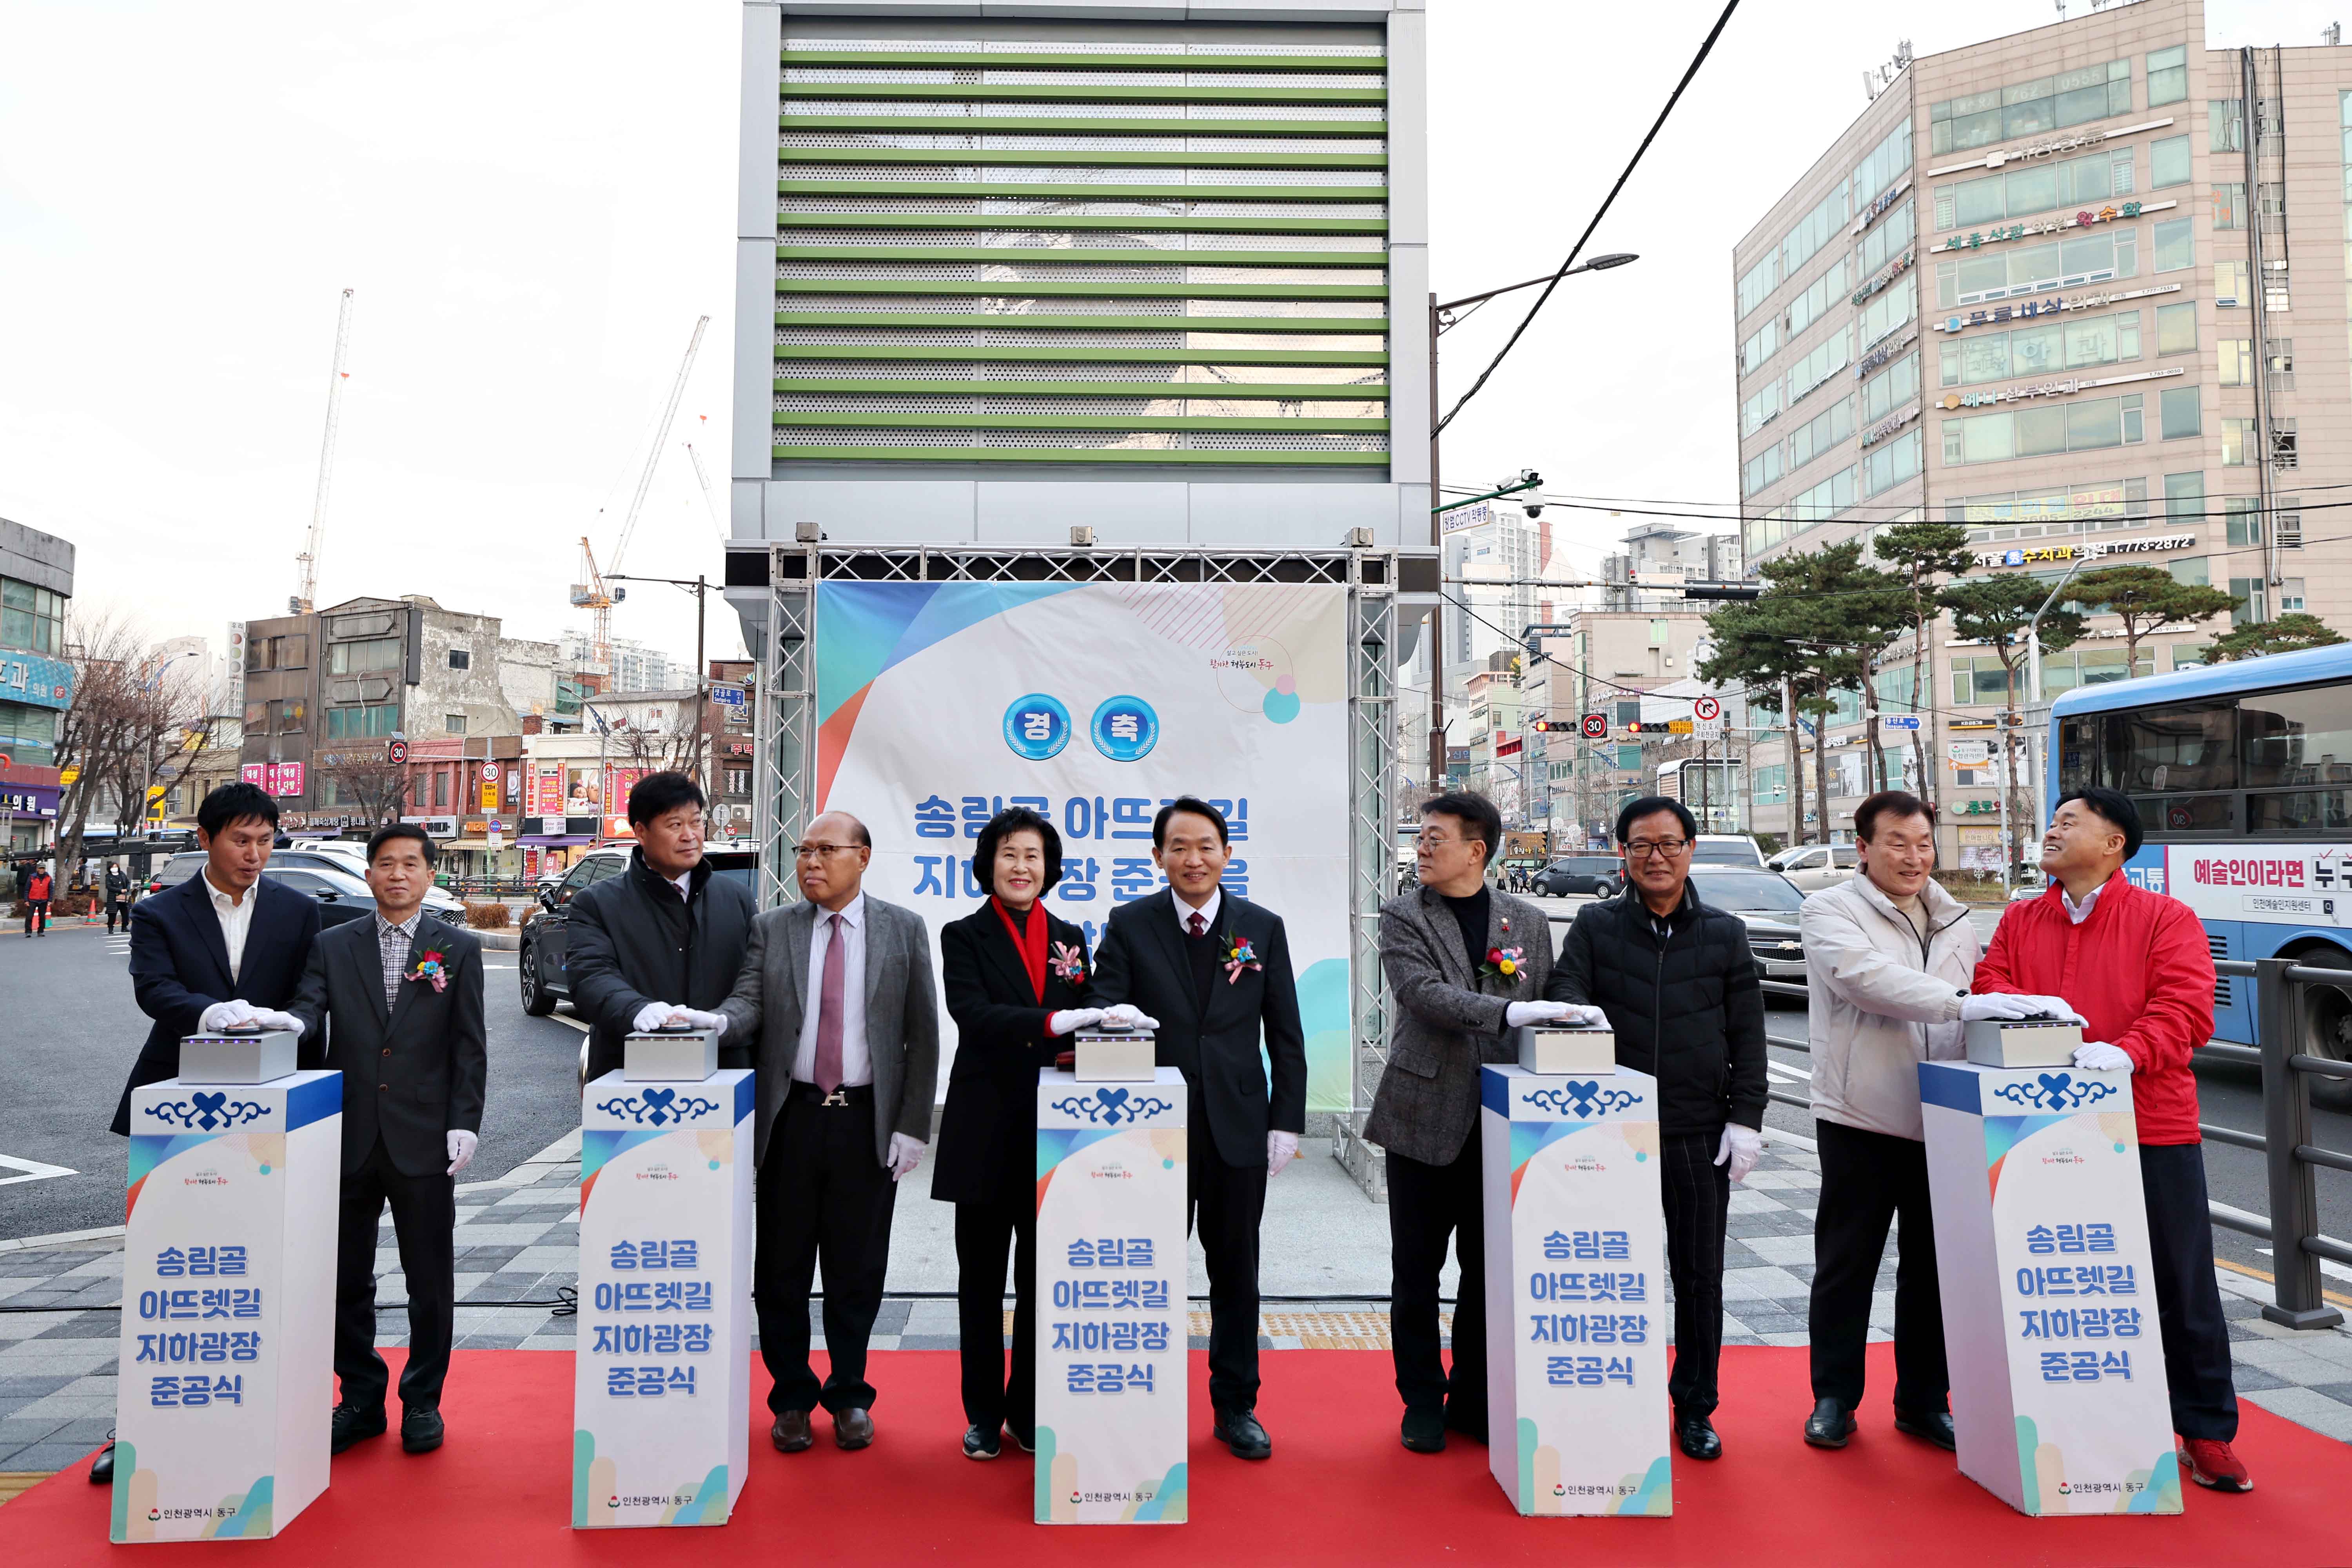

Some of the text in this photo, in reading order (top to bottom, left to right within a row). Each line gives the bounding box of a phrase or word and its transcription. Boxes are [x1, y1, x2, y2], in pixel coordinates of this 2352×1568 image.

[1945, 223, 2025, 251] 세종사관
[2067, 290, 2111, 312] 안과
[1964, 388, 1998, 408] 예나
[2004, 377, 2079, 403] 산부인과
[1444, 506, 1487, 530] 방범 CCTV 작동중
[1973, 552, 2004, 567] 서울
[2112, 537, 2190, 554] T.773-2872
[0, 660, 64, 698] 과 의원 2F
[1231, 660, 1256, 670] 행복도시
[1257, 659, 1274, 670] 동구
[1024, 712, 1138, 742] 경 축
[1587, 721, 1602, 731] 30
[1696, 731, 1719, 739] 우회전금지
[394, 748, 404, 758] 30
[247, 769, 258, 779] 대성
[283, 780, 295, 790] 다방
[284, 768, 295, 778] 대성
[485, 768, 497, 777] 30
[1065, 795, 1249, 842] 아뜨길
[913, 854, 1249, 902] 지장 준을
[2121, 867, 2165, 894] 교통
[2194, 859, 2305, 887] 예술인이라면
[2252, 899, 2312, 912] 인천예술인지원센터
[1068, 1238, 1153, 1267] 송림골
[1544, 1230, 1629, 1259] 송림골
[2027, 1223, 2116, 1254] 송림골
[156, 1246, 247, 1276] 송림골
[611, 1240, 697, 1269] 송림골
[1053, 1280, 1168, 1308] 아뜨렛길
[1531, 1272, 1645, 1301] 아뜨렛길
[2017, 1265, 2136, 1296] 아뜨렛길
[139, 1288, 260, 1319] 아뜨렛길
[595, 1281, 711, 1311] 아뜨렛길
[1053, 1322, 1170, 1350] 지하광장
[1530, 1314, 1648, 1343] 지하광장
[2019, 1307, 2141, 1339] 지하광장
[136, 1331, 261, 1362] 지하광장
[593, 1323, 713, 1354] 지하광장
[1067, 1364, 1153, 1393] 준공식
[1547, 1356, 1633, 1385] 준공식
[2040, 1350, 2131, 1381] 준공식
[150, 1374, 241, 1406] 준공식
[608, 1366, 695, 1396] 준공식
[622, 1495, 692, 1506] 인천광역시 동구
[1085, 1492, 1152, 1502] 인천광역시 동구
[1568, 1486, 1636, 1495] 인천광역시 동구
[2073, 1482, 2144, 1494] 인천광역시 동구
[163, 1507, 236, 1519] 인천광역시 동구
